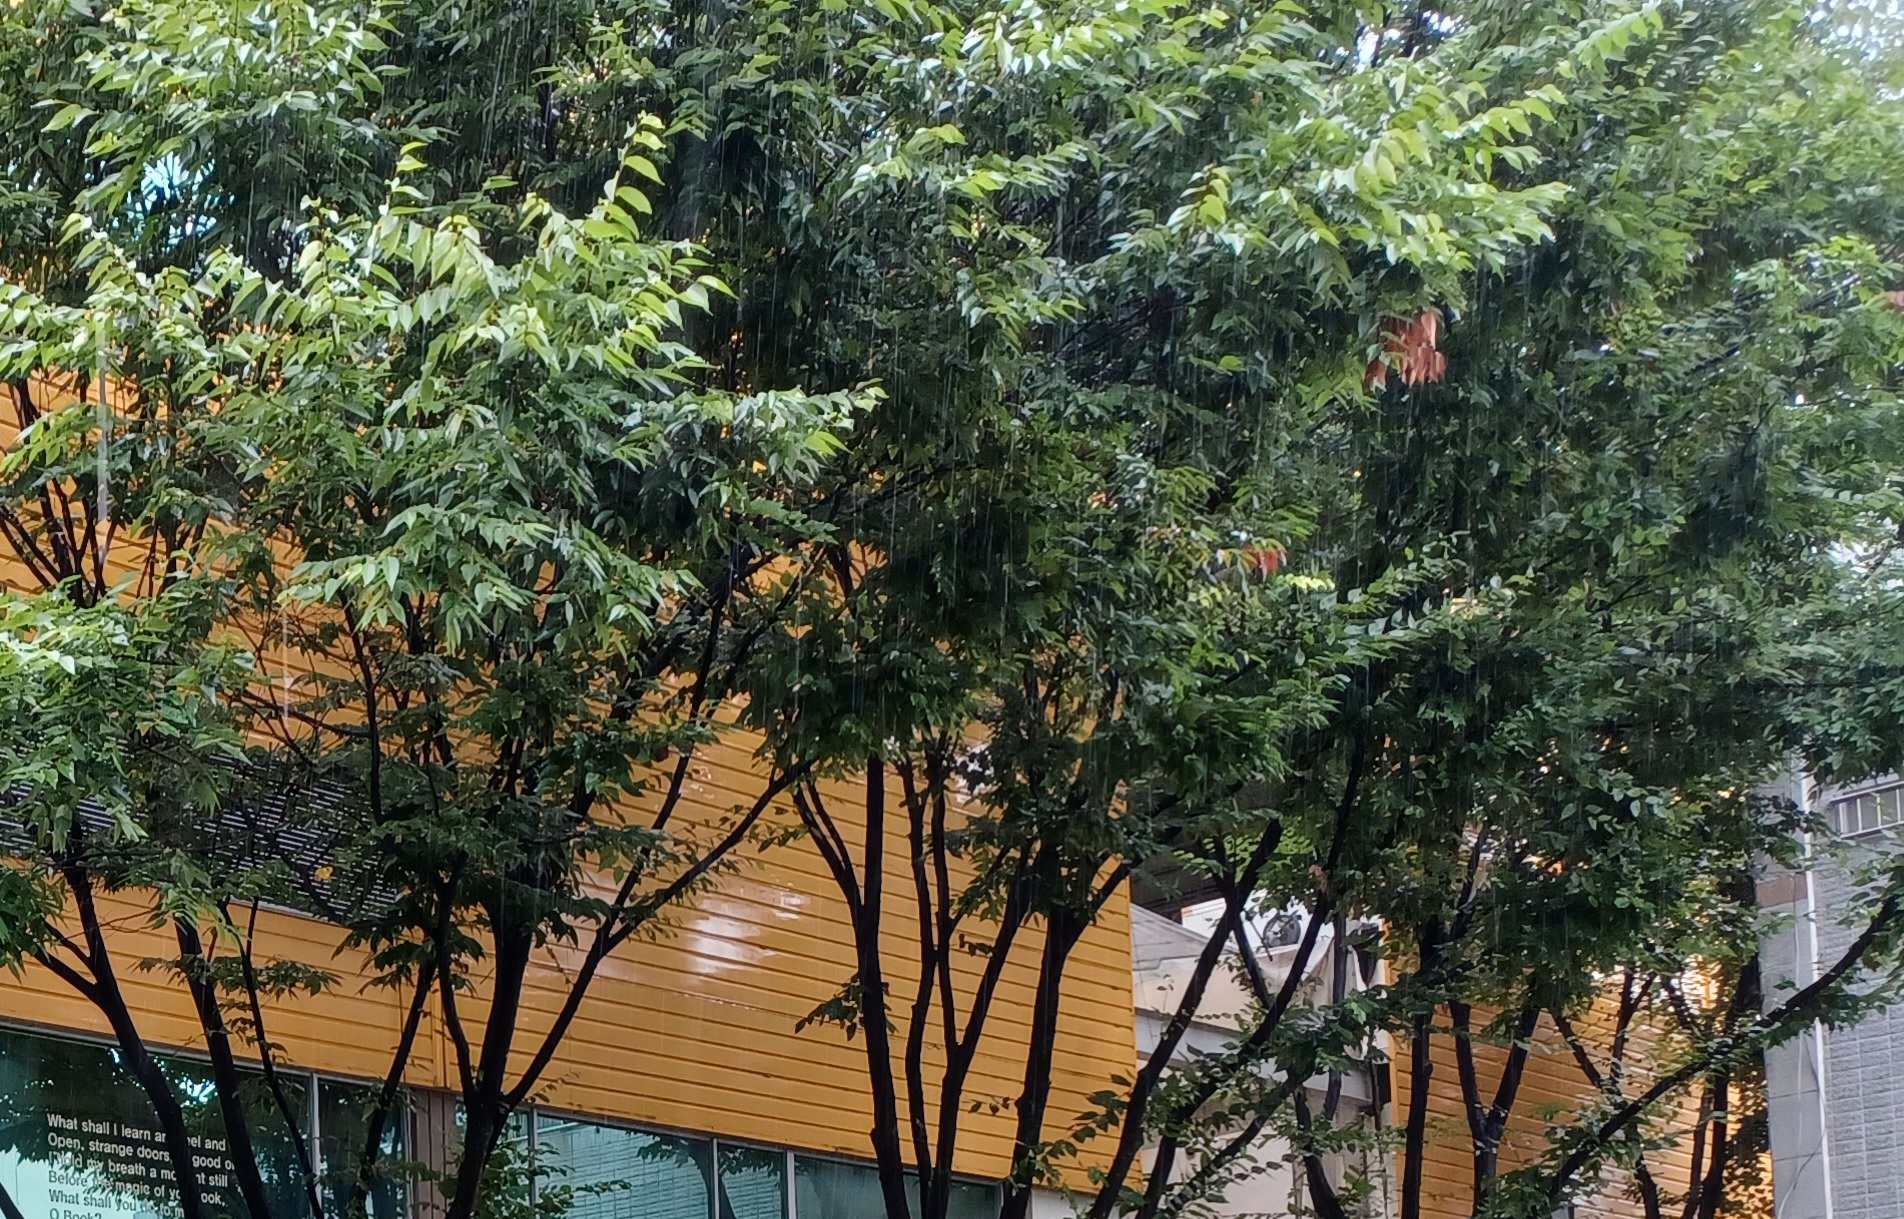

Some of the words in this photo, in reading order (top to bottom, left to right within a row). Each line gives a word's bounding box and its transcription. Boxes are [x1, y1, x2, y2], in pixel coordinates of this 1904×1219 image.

[47, 1113, 77, 1130] What
[81, 1119, 110, 1135] shall
[114, 1123, 117, 1136] I
[121, 1124, 151, 1141] learn
[204, 1139, 226, 1151] and
[88, 1139, 134, 1157] strange
[191, 1154, 221, 1168] good
[48, 1170, 88, 1187] Before
[115, 1181, 150, 1196] magic
[153, 1184, 165, 1197] of
[108, 1159, 146, 1176] breath
[149, 1167, 157, 1178] a
[208, 1173, 228, 1188] still
[48, 1188, 79, 1205] What
[83, 1195, 112, 1209] shall
[116, 1199, 137, 1212] you
